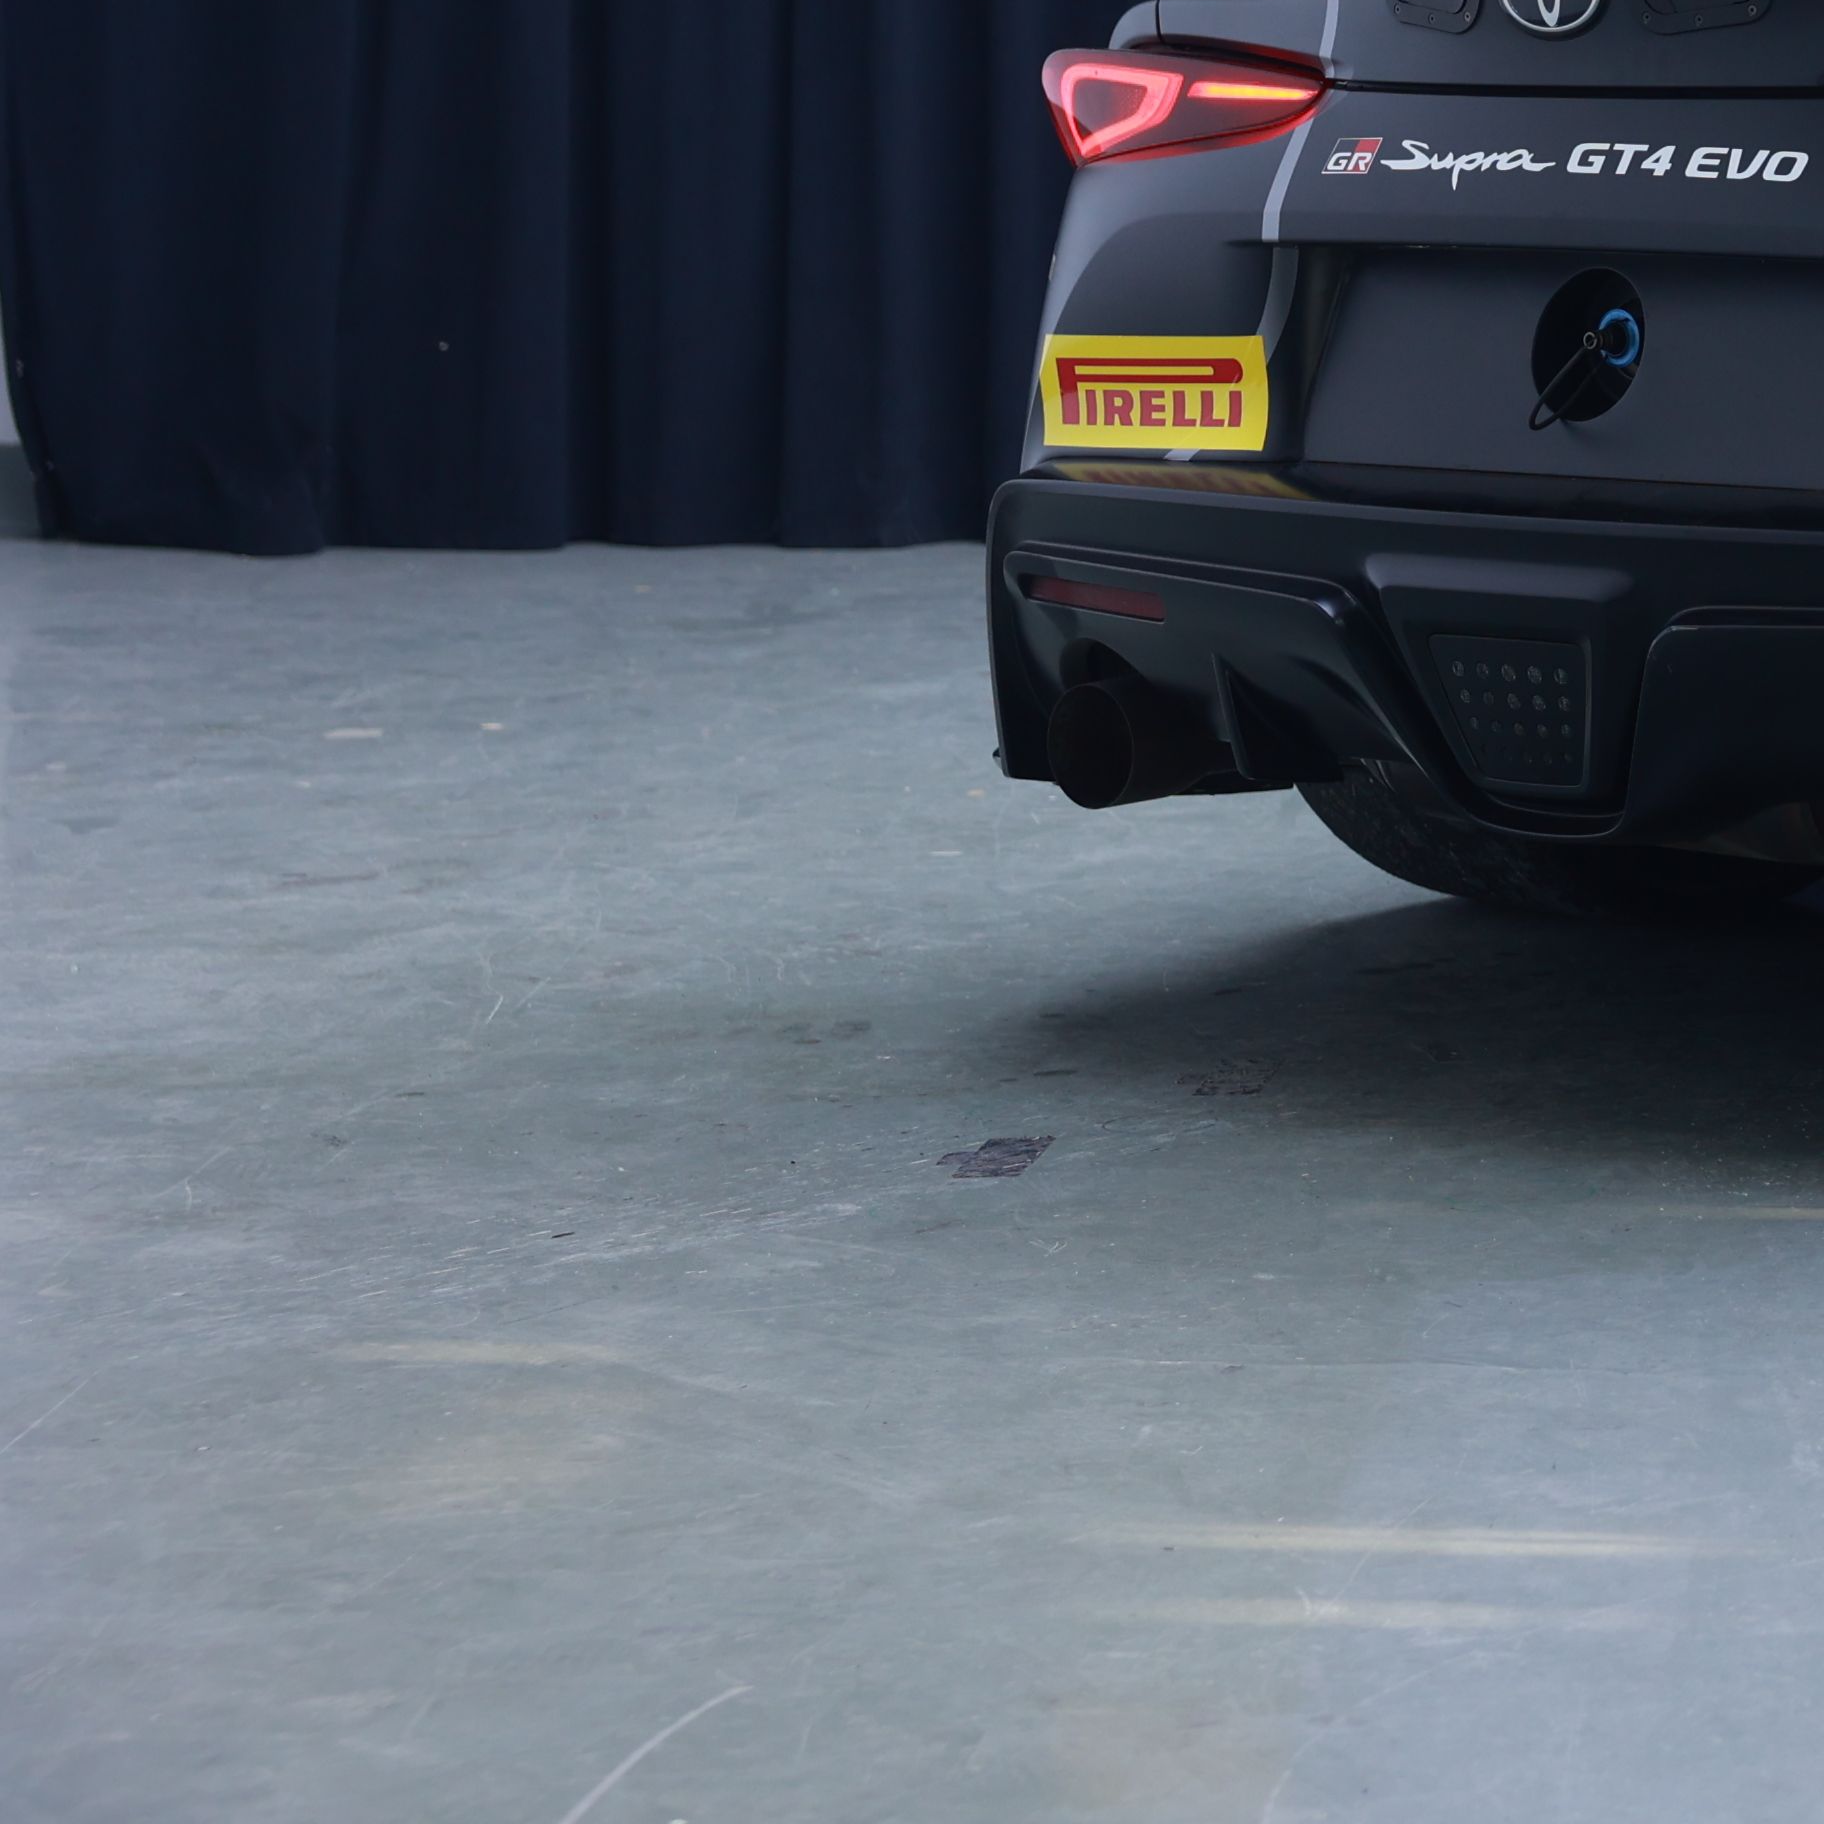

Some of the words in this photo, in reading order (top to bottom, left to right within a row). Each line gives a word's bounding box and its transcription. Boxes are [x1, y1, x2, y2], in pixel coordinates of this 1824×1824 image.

[1326, 152, 1368, 173] GR
[1381, 140, 1556, 190] Supra
[1566, 142, 1672, 176] GT4
[1684, 146, 1810, 182] EVO
[1056, 356, 1244, 429] PIRELLI
